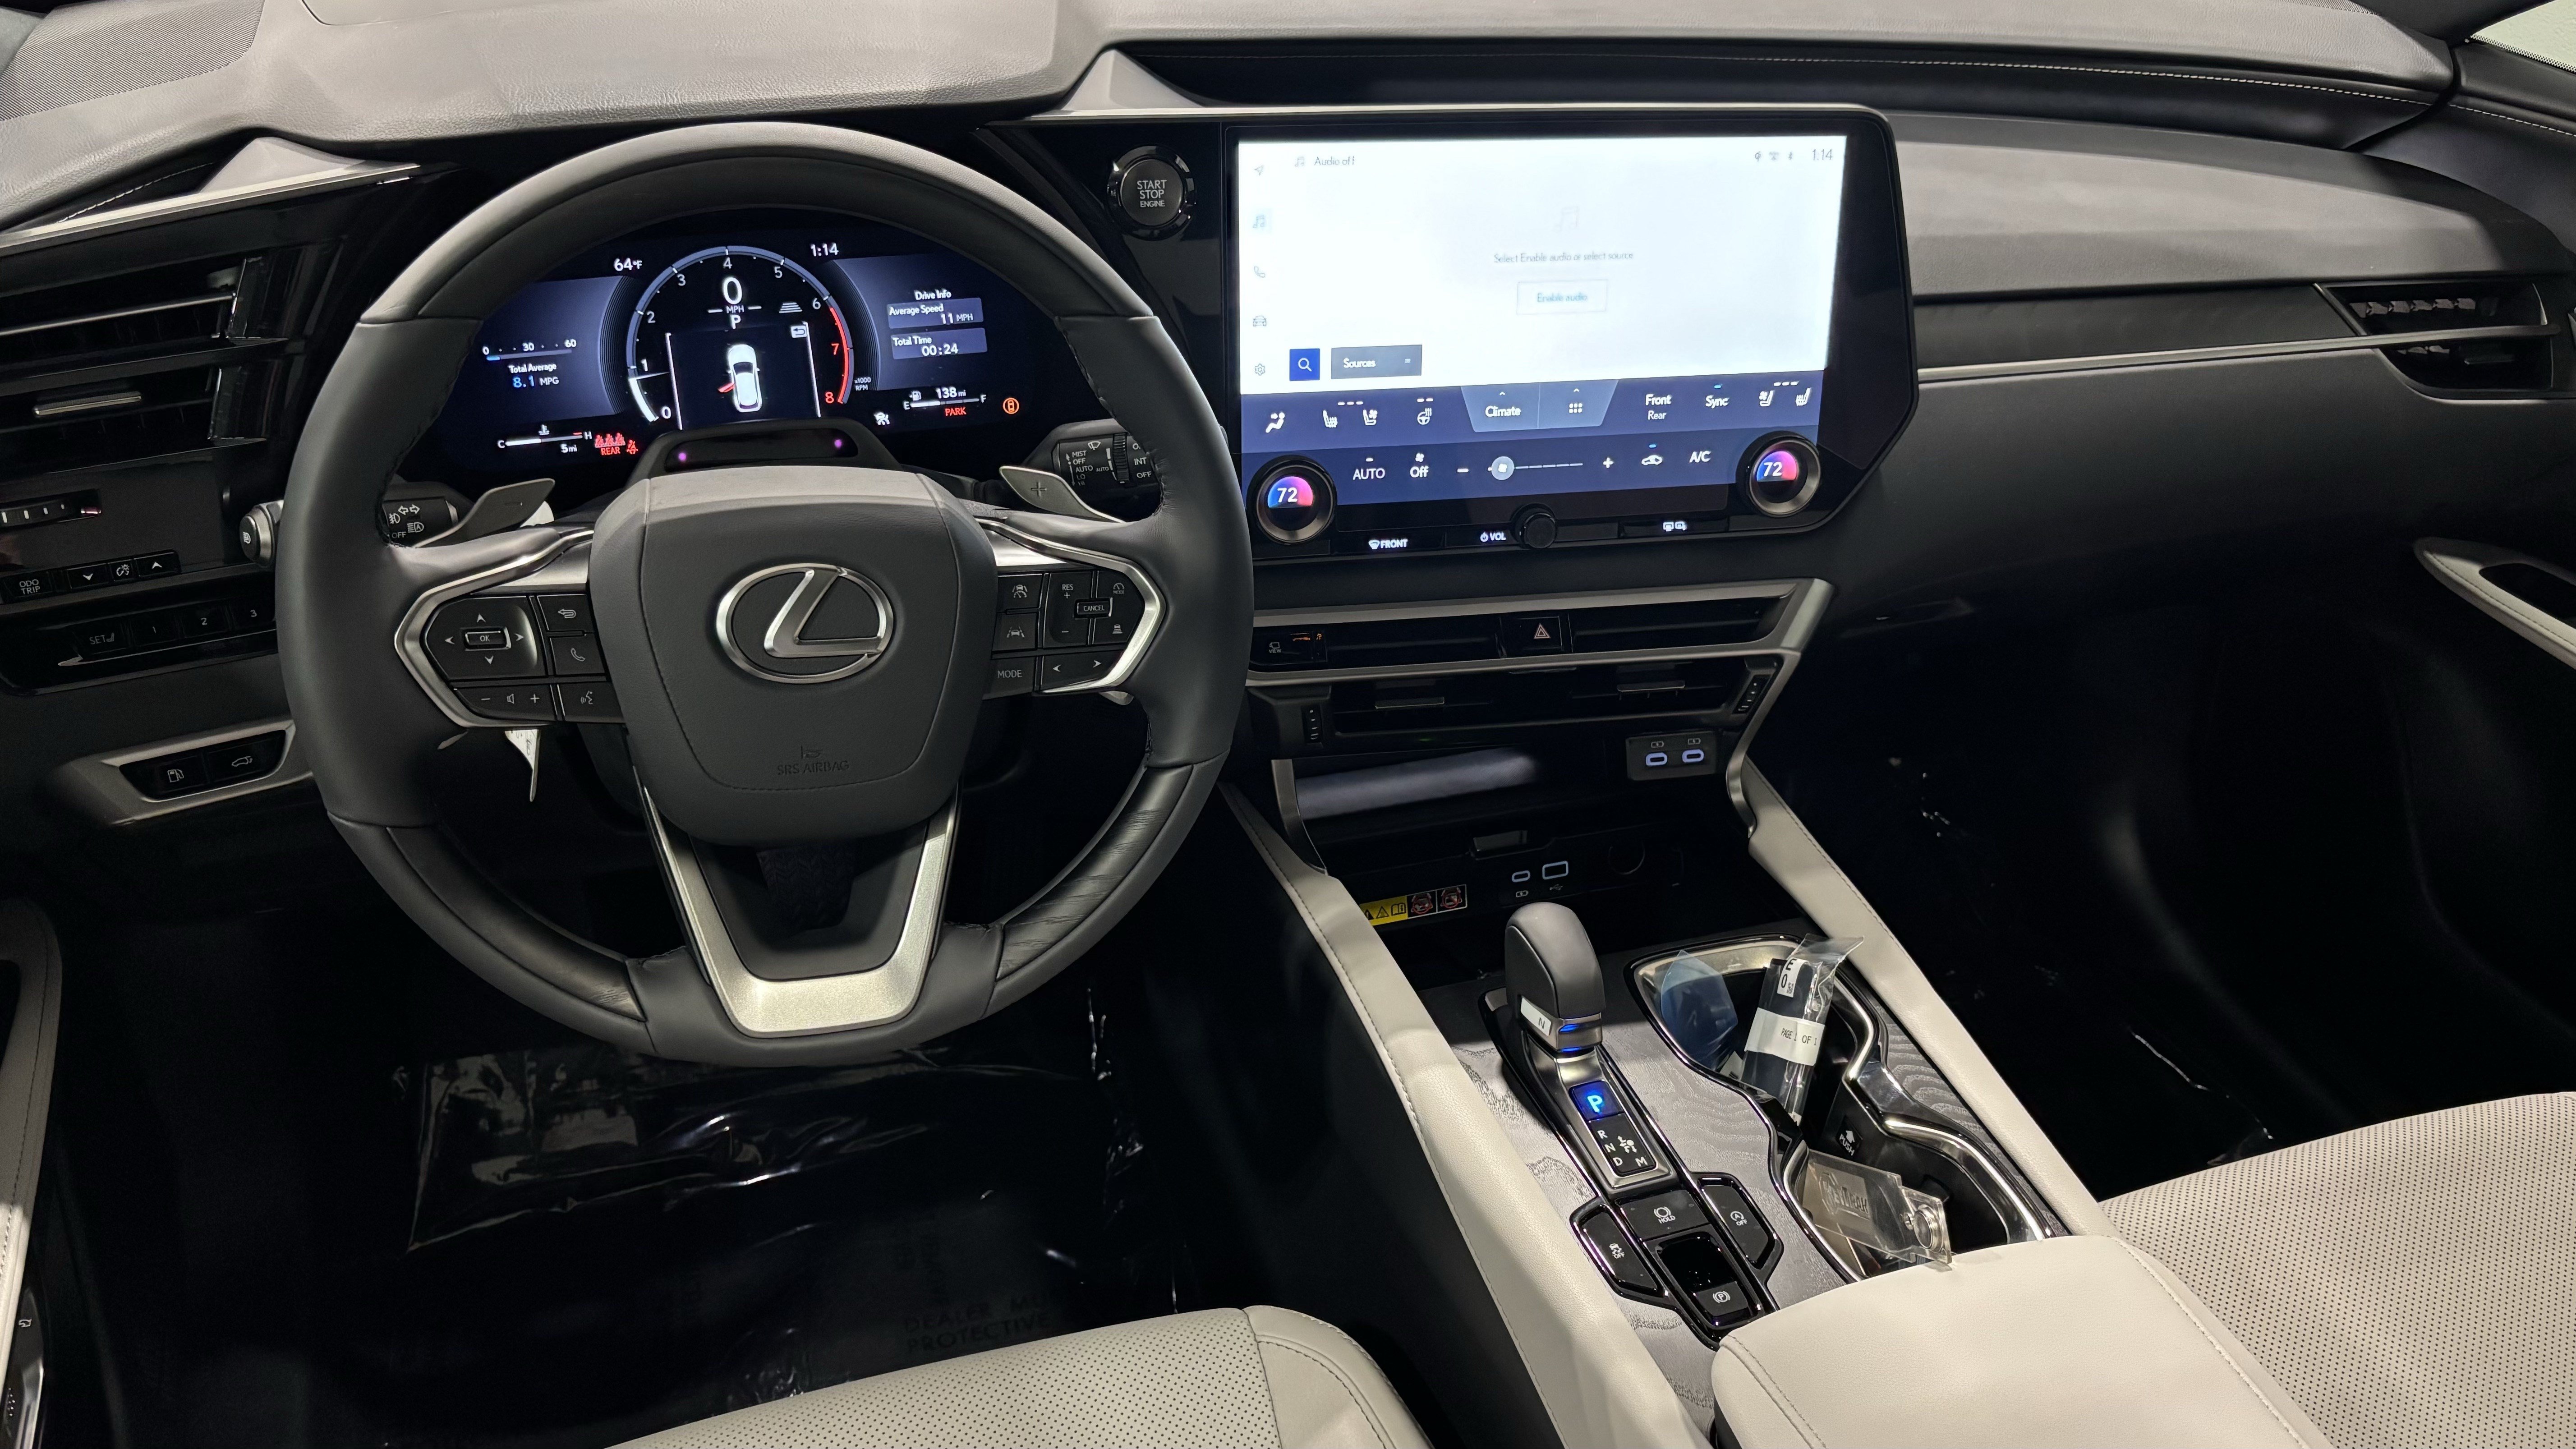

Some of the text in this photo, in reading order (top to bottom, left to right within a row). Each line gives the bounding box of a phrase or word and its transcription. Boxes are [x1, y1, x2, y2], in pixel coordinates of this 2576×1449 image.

[1812, 149, 1833, 161] 1:14
[1314, 156, 1340, 166] Audio
[1137, 180, 1167, 189] START
[1140, 189, 1164, 199] STOP
[810, 243, 839, 257] 1:14
[723, 257, 732, 269] 4
[1494, 253, 1518, 263] Select
[1520, 253, 1547, 262] Enable
[1550, 253, 1571, 262] audio
[1583, 252, 1605, 260] select
[774, 267, 782, 279] 5
[677, 274, 686, 286] 3
[722, 276, 742, 304] 0
[915, 289, 952, 300] Drive Info
[1537, 292, 1588, 303] Enable audio
[726, 305, 745, 313] MPH
[812, 298, 821, 309] 6
[889, 304, 944, 316] Average Speed
[647, 311, 656, 323] 2
[730, 314, 741, 329] P
[941, 313, 974, 324] 11 MPH
[892, 335, 932, 346] Total Time
[482, 339, 577, 355] 0 30 60
[831, 343, 839, 355] 7
[921, 343, 958, 356] 00:24
[508, 363, 557, 373] Total Average
[641, 359, 649, 372] 1
[1343, 357, 1375, 369] Sources
[512, 375, 559, 388] 8.1 MPG
[825, 391, 834, 404] 8
[980, 394, 987, 403] F
[1645, 394, 1672, 405] Front
[1705, 394, 1729, 408] Sync
[903, 401, 910, 410] E
[661, 406, 672, 419] 0
[945, 407, 967, 416] PARK
[1485, 405, 1521, 418] Climate
[1647, 410, 1666, 420] Rear
[584, 431, 592, 440] H
[497, 440, 505, 448] C
[601, 446, 621, 455] REAR
[1134, 457, 1147, 465] INT
[1689, 451, 1711, 464] A/C
[1353, 468, 1385, 480] AUTO
[1410, 465, 1429, 478] Off
[1763, 461, 1783, 477] 72
[1277, 487, 1298, 503] 72
[1489, 532, 1506, 541] VOL
[1380, 538, 1408, 549] FRONT
[19, 579, 39, 588] ODO
[20, 586, 41, 595] TRIP
[201, 617, 207, 626] 2
[89, 635, 105, 645] SET
[997, 670, 1022, 678] MODE
[777, 760, 849, 776] SRS AIRBAG
[1781, 1028, 1793, 1039] PAGE
[1802, 1035, 1812, 1043] OF
[1587, 1095, 1603, 1113] P
[1598, 1130, 1607, 1139] R
[1605, 1143, 1616, 1153] N
[1839, 1134, 1855, 1156] PUSH
[1613, 1156, 1648, 1167] D M
